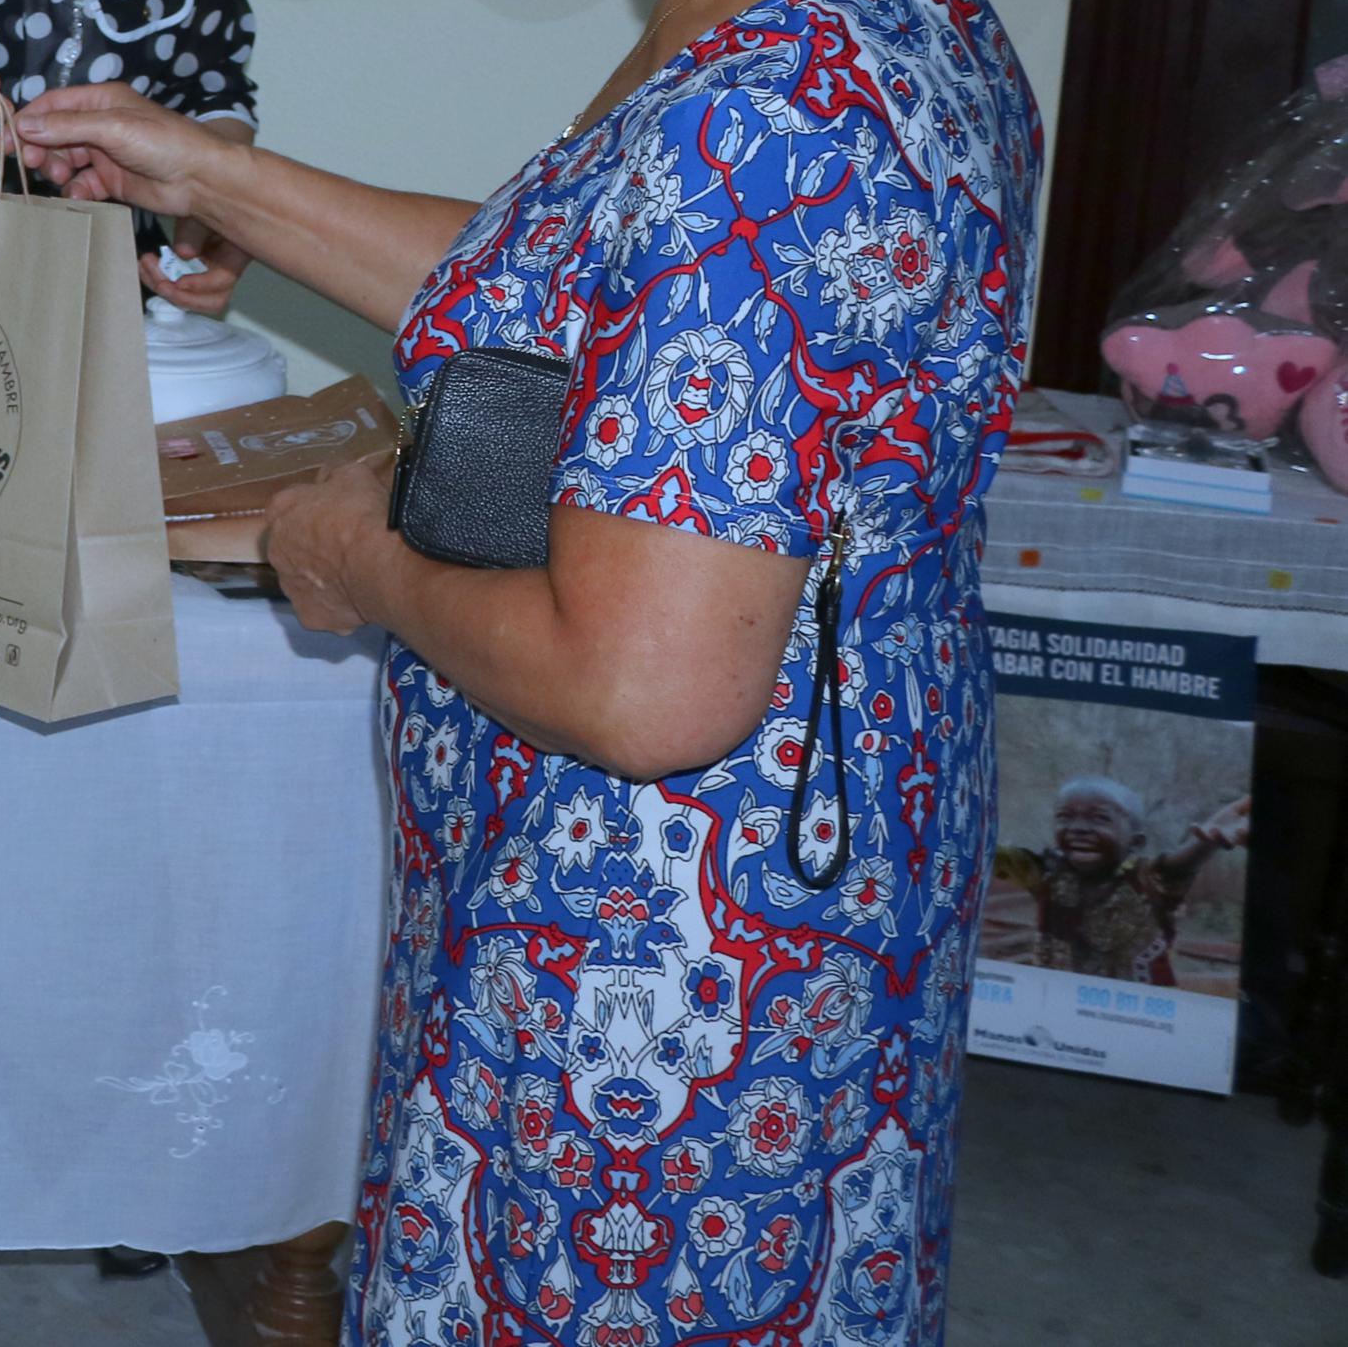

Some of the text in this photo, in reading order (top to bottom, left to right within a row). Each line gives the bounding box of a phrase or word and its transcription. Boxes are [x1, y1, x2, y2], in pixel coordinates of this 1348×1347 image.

[987, 625, 1185, 667] TAGIA SOLIDARIDAD
[993, 652, 1221, 700] ABAR CON EL HAMBRE
